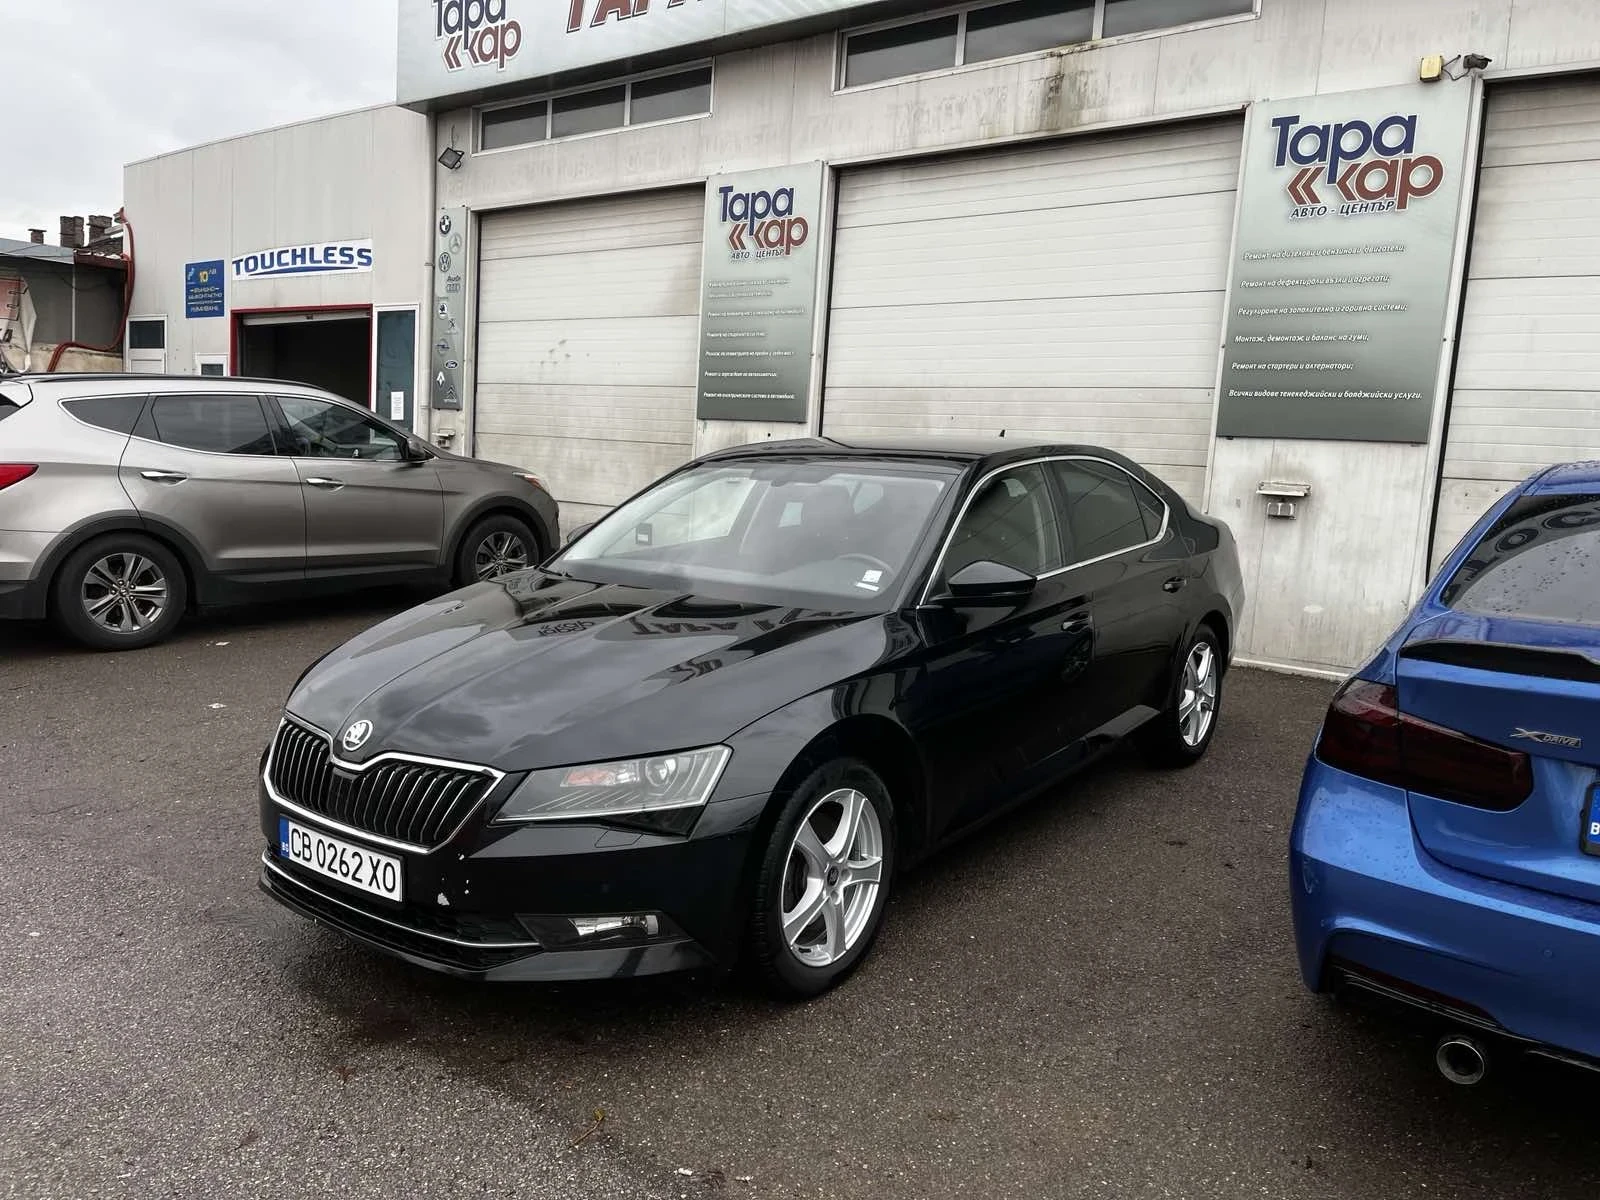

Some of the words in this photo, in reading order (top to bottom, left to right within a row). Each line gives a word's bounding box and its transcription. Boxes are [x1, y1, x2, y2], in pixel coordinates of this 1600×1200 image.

[1271, 114, 1418, 185] Тара
[718, 185, 795, 236] Тара
[1290, 205, 1327, 218] АВТО
[1339, 201, 1396, 216] ЦЕНТЪР
[731, 251, 750, 260] АВТО
[1243, 252, 1269, 261] Ремонт
[231, 246, 373, 276] TOUCHLESS
[1240, 280, 1266, 289] Ремонт
[1237, 306, 1278, 316] Регулиране
[1234, 335, 1266, 343] Монтаж,
[1267, 333, 1304, 342] демонтаж
[1312, 333, 1337, 341] баланс
[1231, 362, 1257, 370] Ремонт
[1266, 363, 1299, 371] стартери
[1228, 389, 1253, 397] Всички
[1253, 389, 1279, 397] видове
[1279, 389, 1337, 399] тенекеджийски
[1343, 389, 1393, 399] бояджийски
[290, 828, 313, 862] CB
[316, 838, 363, 884] 0262
[368, 855, 396, 894] XO
